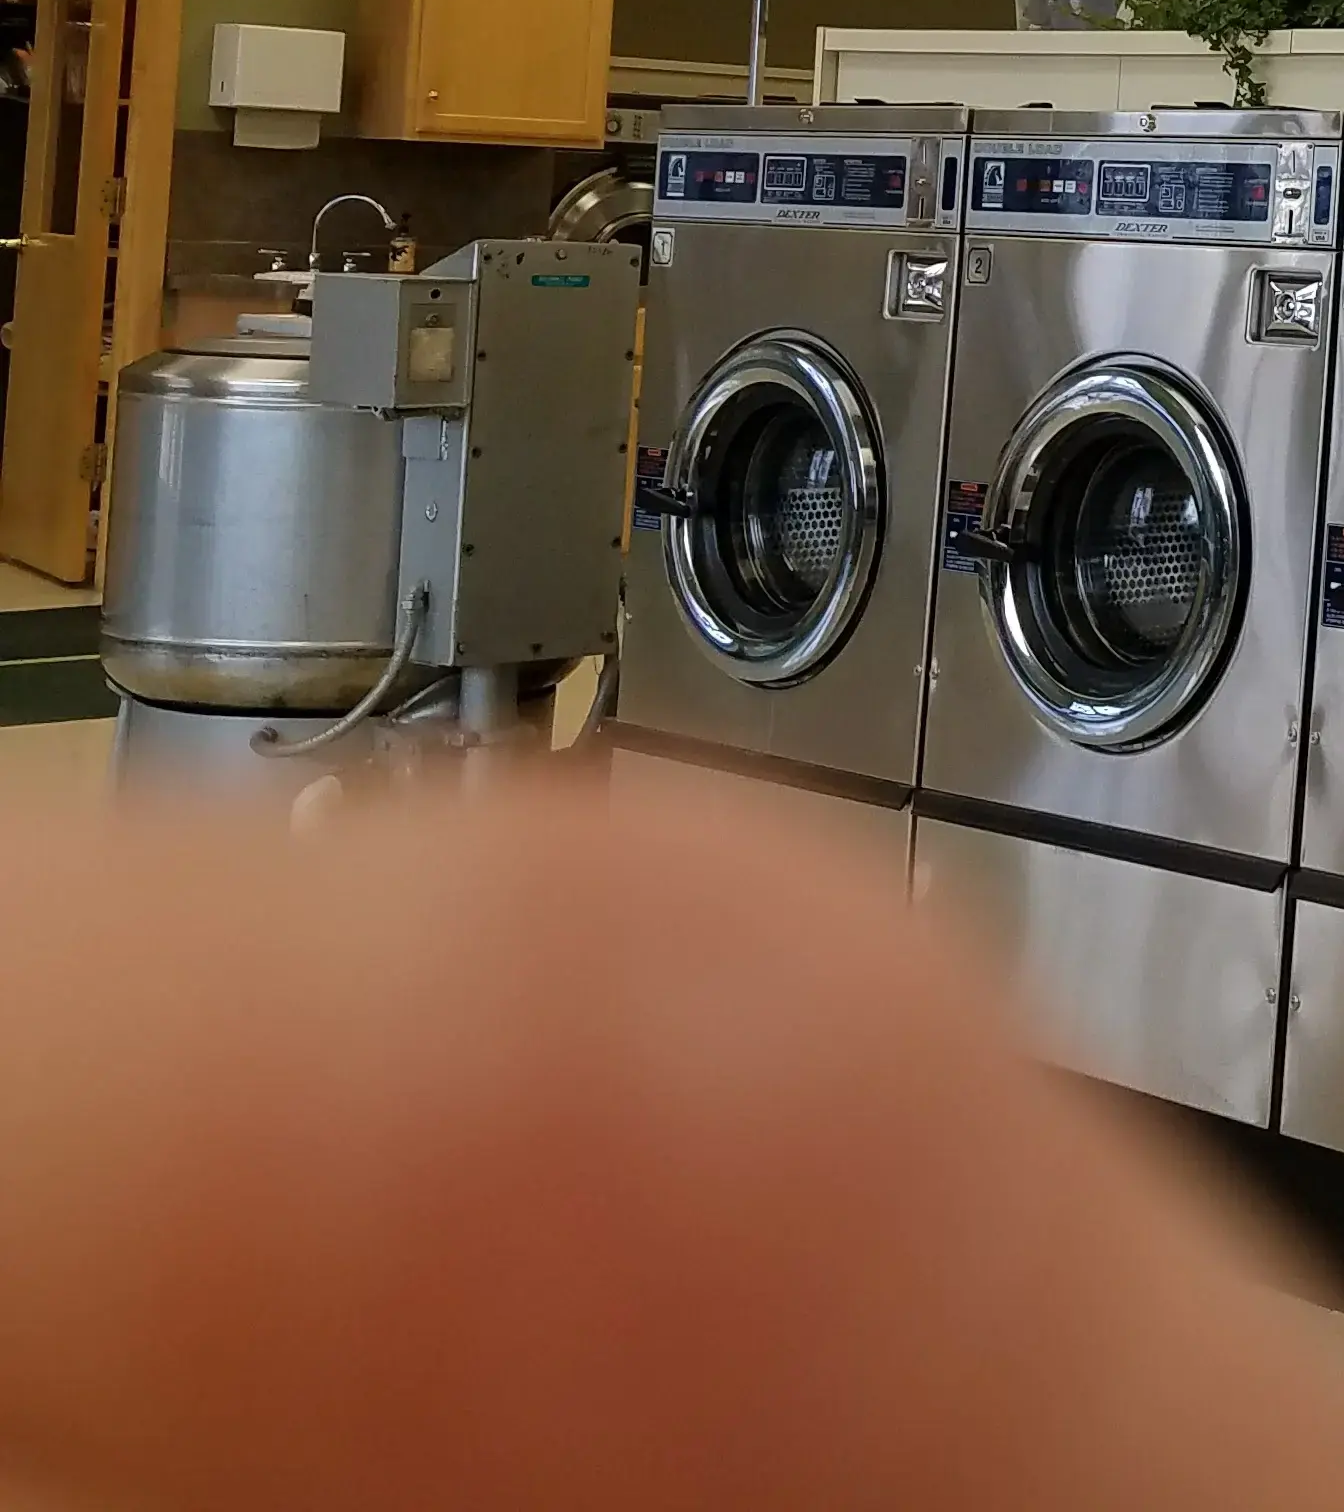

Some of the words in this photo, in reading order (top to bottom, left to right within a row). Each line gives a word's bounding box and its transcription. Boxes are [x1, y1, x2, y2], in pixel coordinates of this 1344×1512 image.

[776, 209, 820, 219] DEXTER
[1115, 222, 1168, 233] DEXTER
[974, 256, 983, 274] 2
